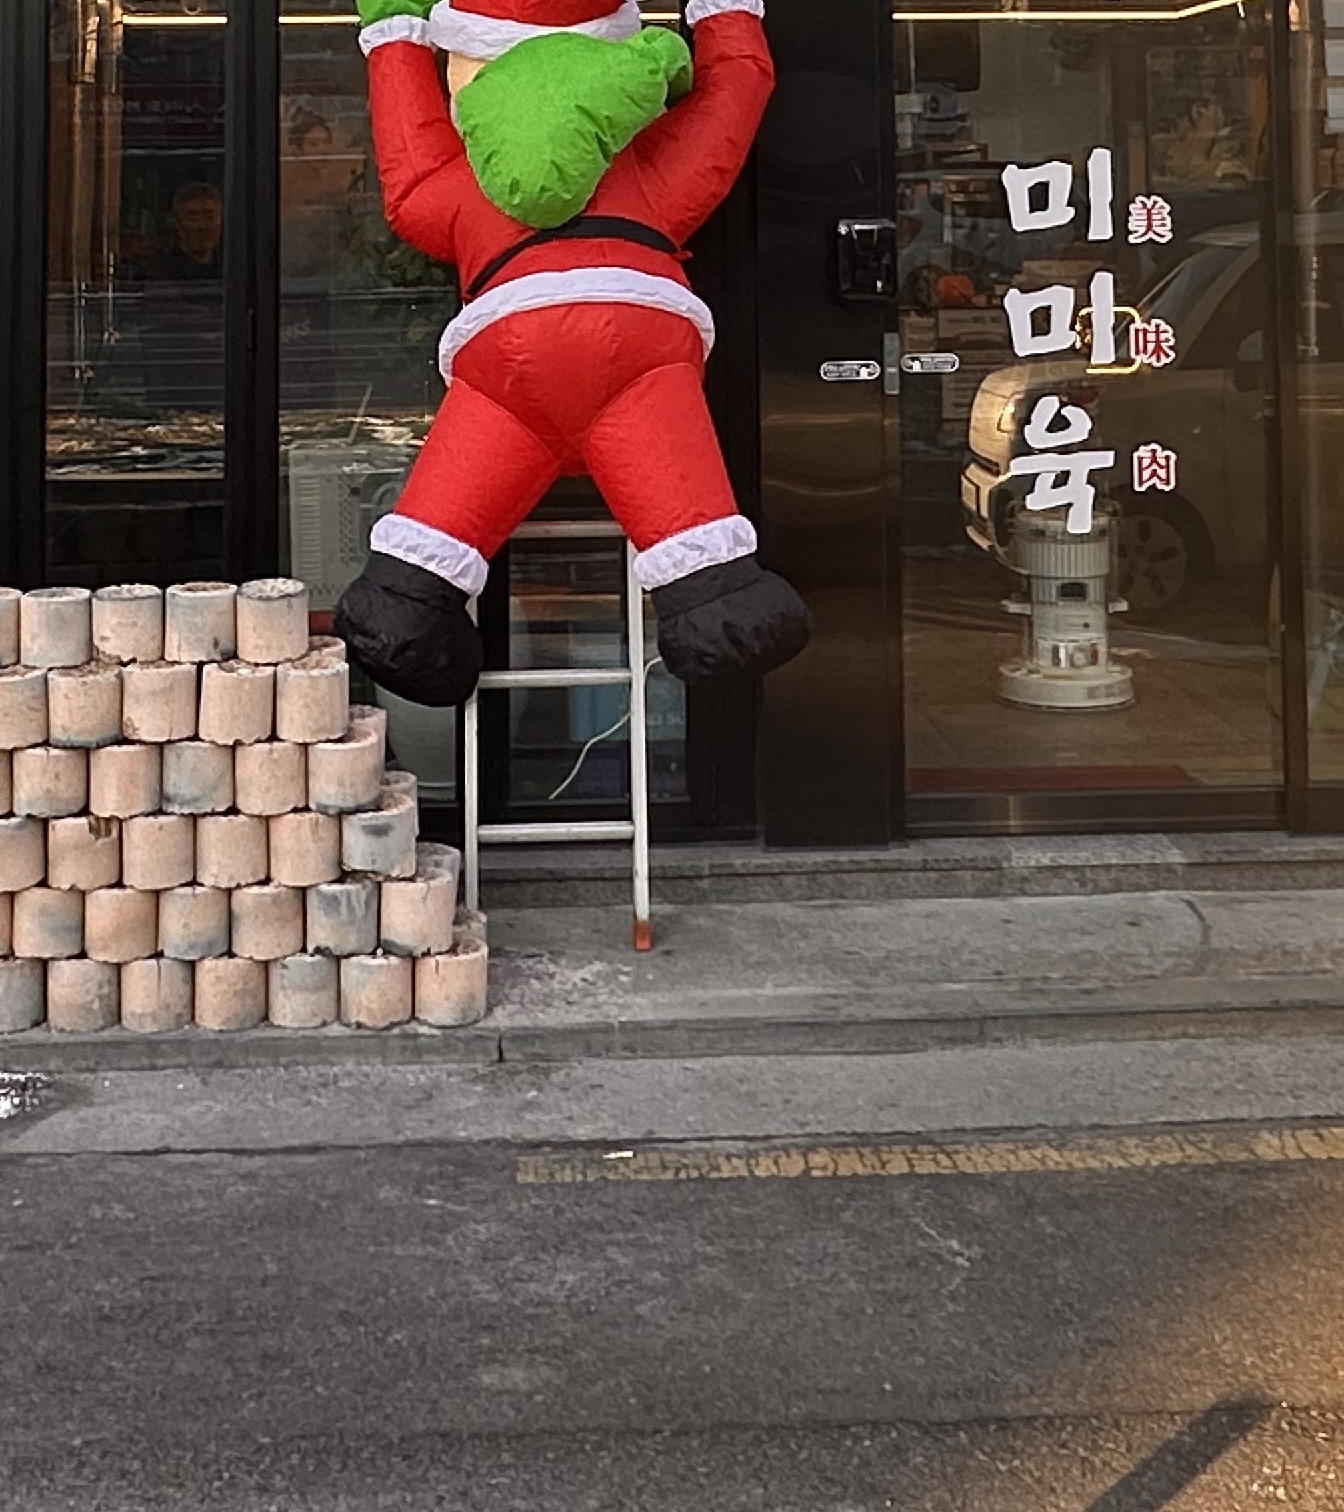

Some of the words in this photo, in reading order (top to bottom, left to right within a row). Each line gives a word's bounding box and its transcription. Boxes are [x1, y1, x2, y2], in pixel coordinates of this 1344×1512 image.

[1002, 148, 1115, 242] 미
[1128, 195, 1173, 244] 美
[1003, 271, 1116, 365] 미
[1129, 319, 1176, 367] 味
[1009, 395, 1116, 534] 육
[1132, 443, 1177, 492] 肉
